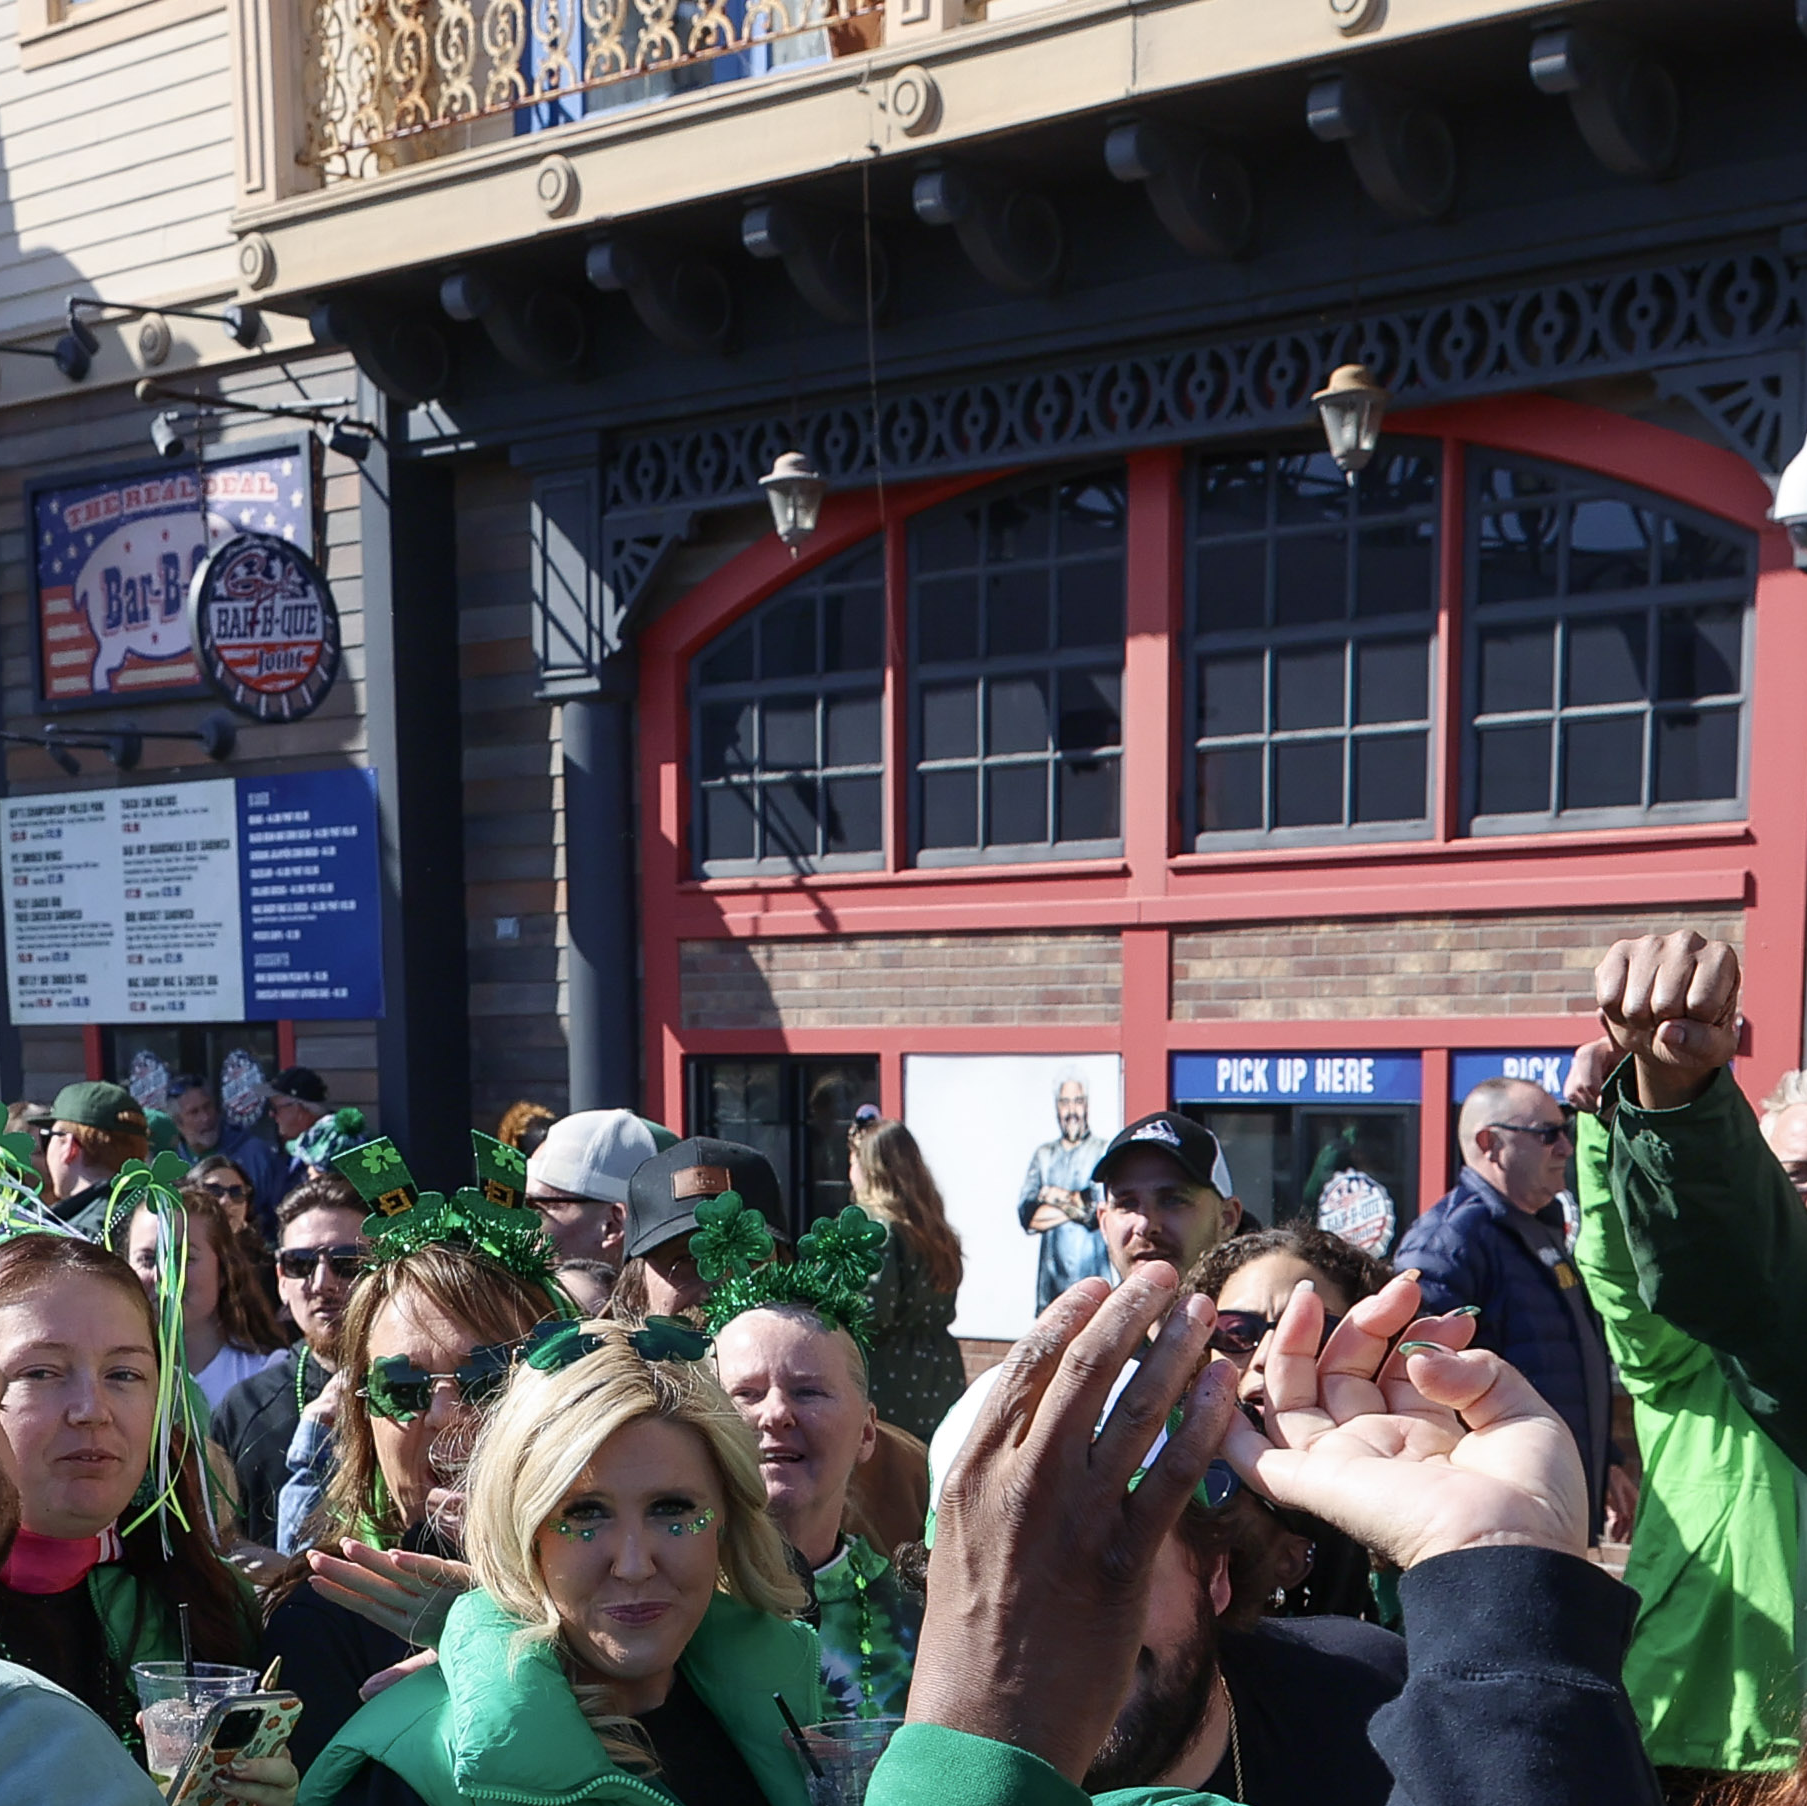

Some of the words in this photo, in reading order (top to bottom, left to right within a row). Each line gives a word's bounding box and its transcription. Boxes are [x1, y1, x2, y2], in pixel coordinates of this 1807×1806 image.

[65, 492, 120, 531] THE
[123, 477, 196, 511] REAL
[203, 472, 277, 500] DEAL
[216, 603, 319, 640] BAR-B-QUE
[1217, 1058, 1269, 1093] PICK
[1277, 1058, 1309, 1094] UP
[1315, 1058, 1375, 1094] HERE
[1503, 1057, 1562, 1093] PICK
